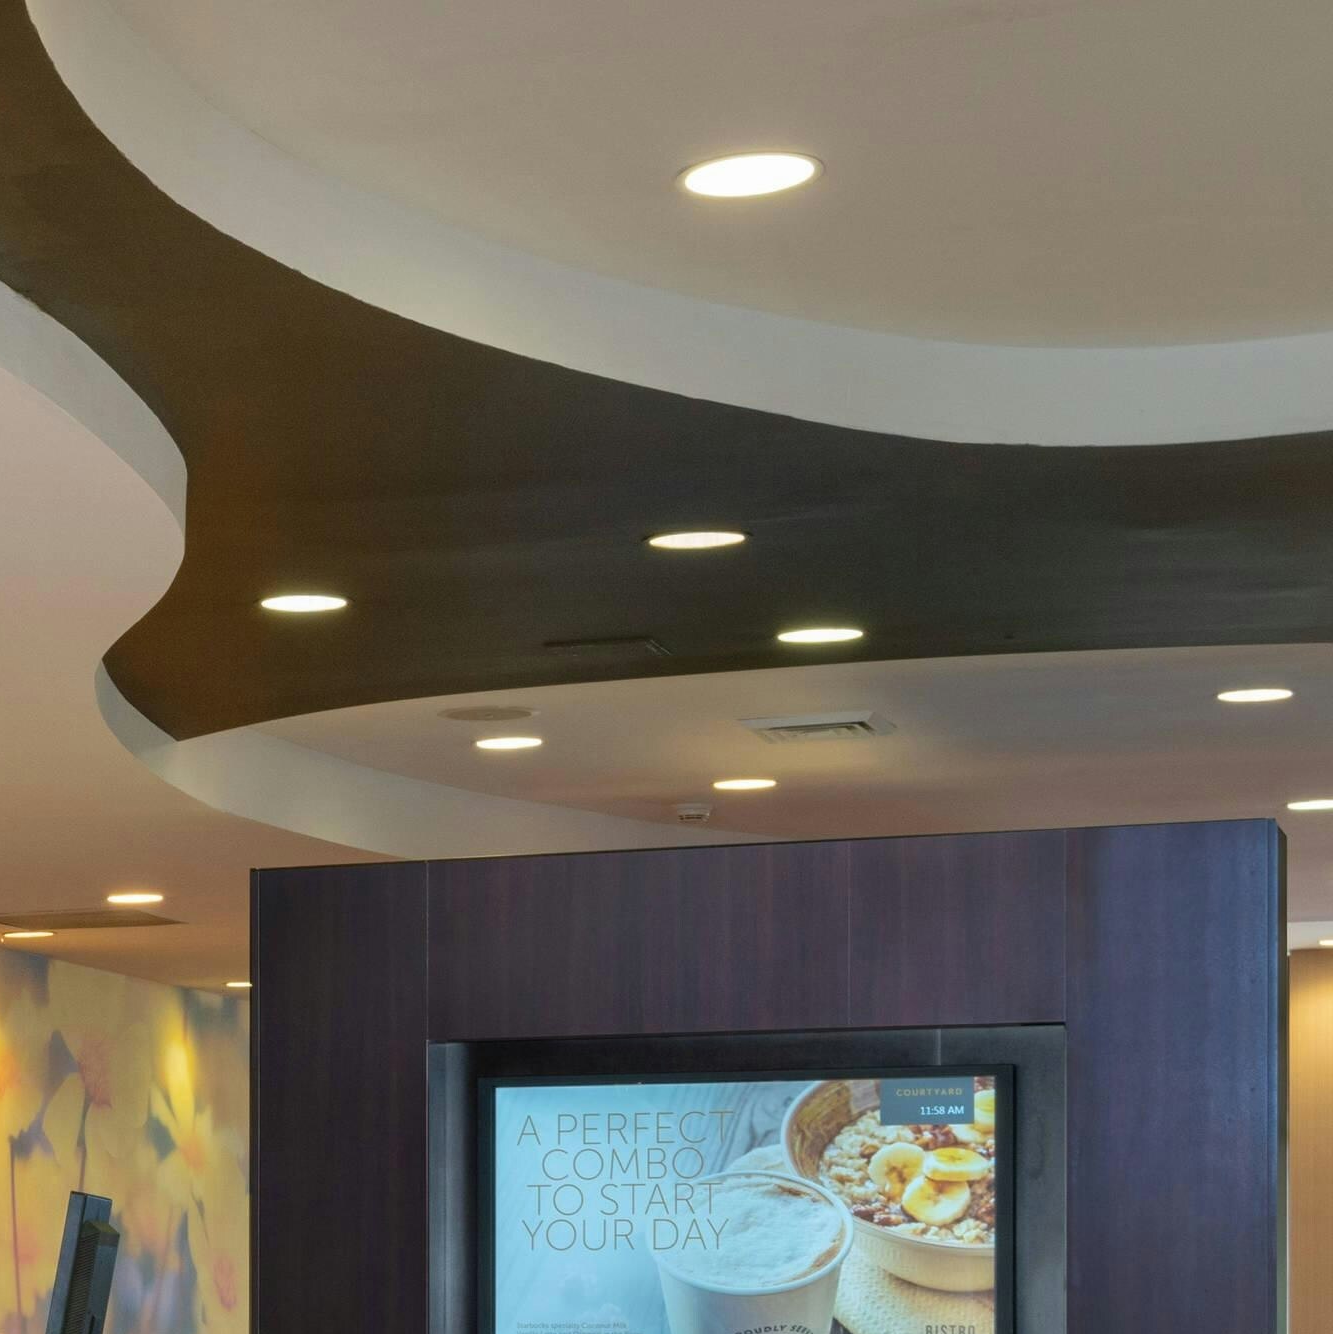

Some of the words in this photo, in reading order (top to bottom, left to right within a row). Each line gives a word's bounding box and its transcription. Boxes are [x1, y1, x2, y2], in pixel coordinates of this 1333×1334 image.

[895, 1087, 963, 1097] COURTYARD
[920, 1105, 945, 1116] 11:58
[947, 1105, 965, 1115] AM
[517, 1115, 541, 1146] A
[557, 1111, 734, 1145] PERFECT
[542, 1147, 704, 1181] COMBO
[527, 1184, 584, 1216] TO
[600, 1183, 723, 1216] START
[521, 1218, 635, 1251] YOUR
[652, 1218, 729, 1251] DAY
